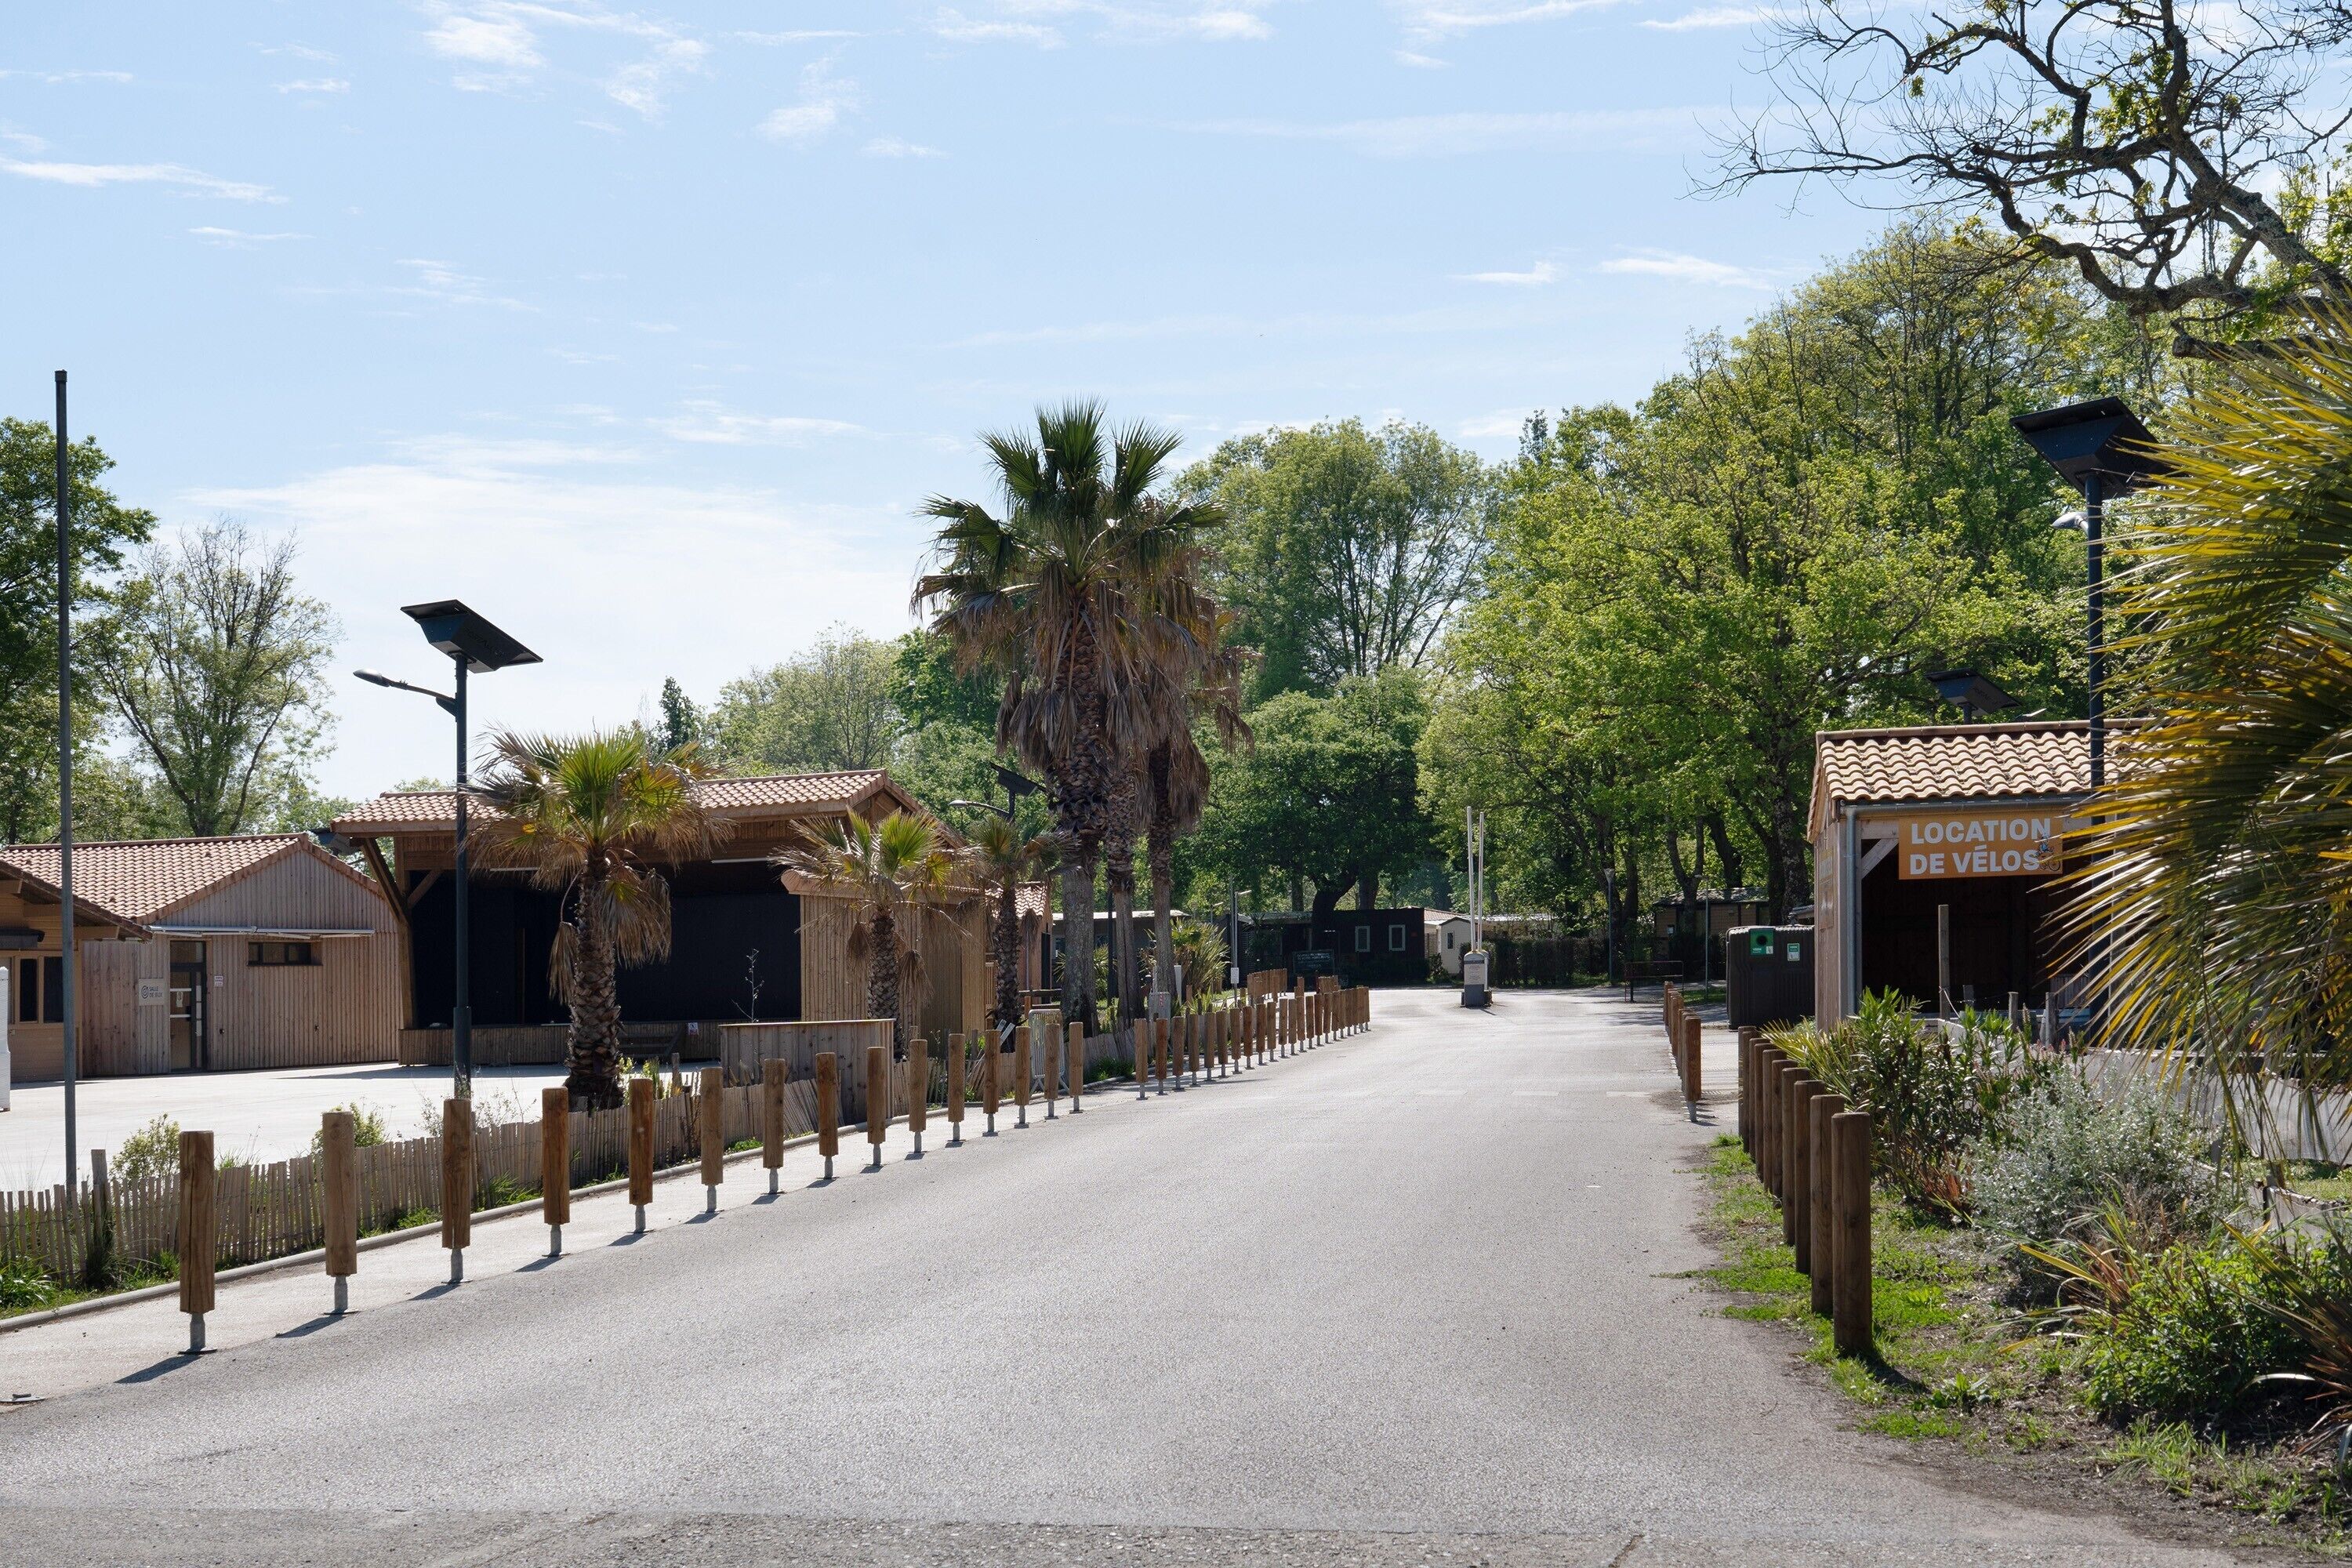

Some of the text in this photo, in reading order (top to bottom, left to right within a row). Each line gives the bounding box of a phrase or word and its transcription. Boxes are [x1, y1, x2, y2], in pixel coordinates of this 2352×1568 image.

[1911, 818, 2051, 844] LOCATION
[1910, 844, 2039, 875] DE VÉLOS
